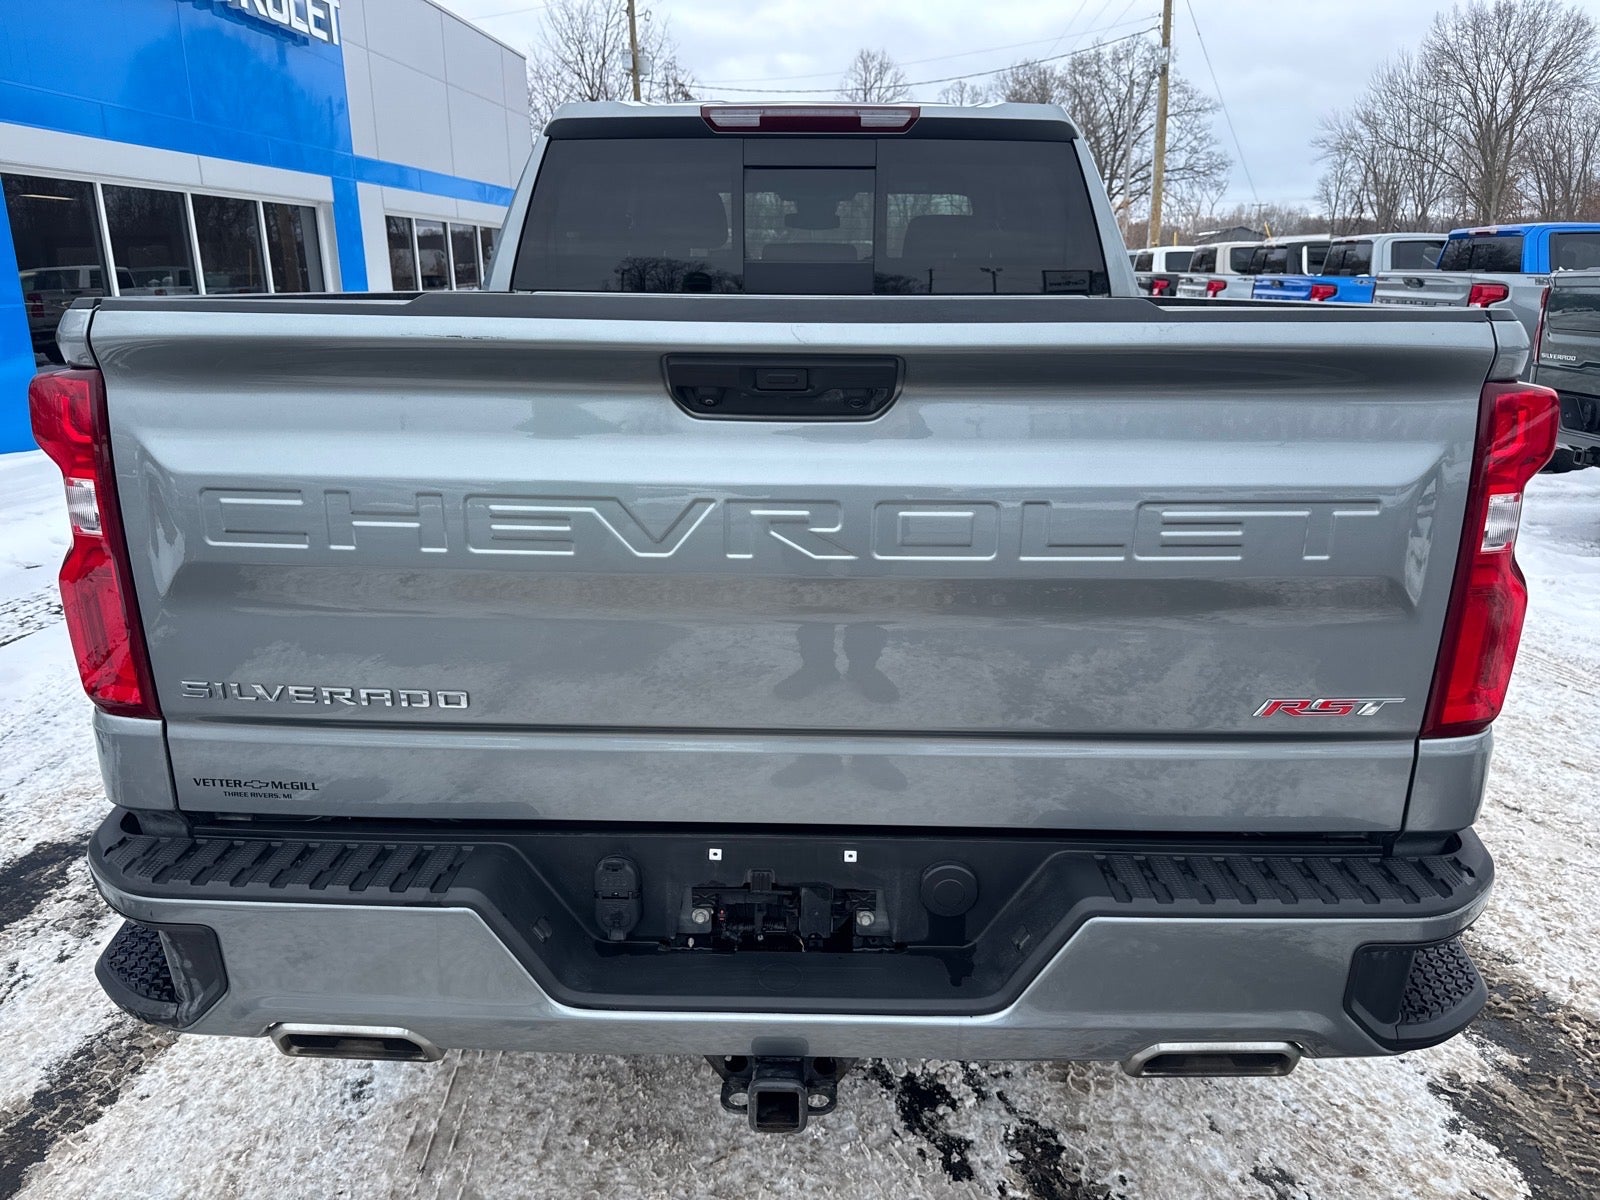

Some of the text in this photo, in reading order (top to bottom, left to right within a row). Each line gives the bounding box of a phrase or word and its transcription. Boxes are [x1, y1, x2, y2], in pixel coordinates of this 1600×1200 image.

[240, 0, 340, 46] OLET
[199, 486, 1382, 562] CHEVROLET
[180, 680, 470, 709] SILVERADO
[1252, 697, 1406, 718] RST
[193, 778, 319, 791] VETTER McGILL
